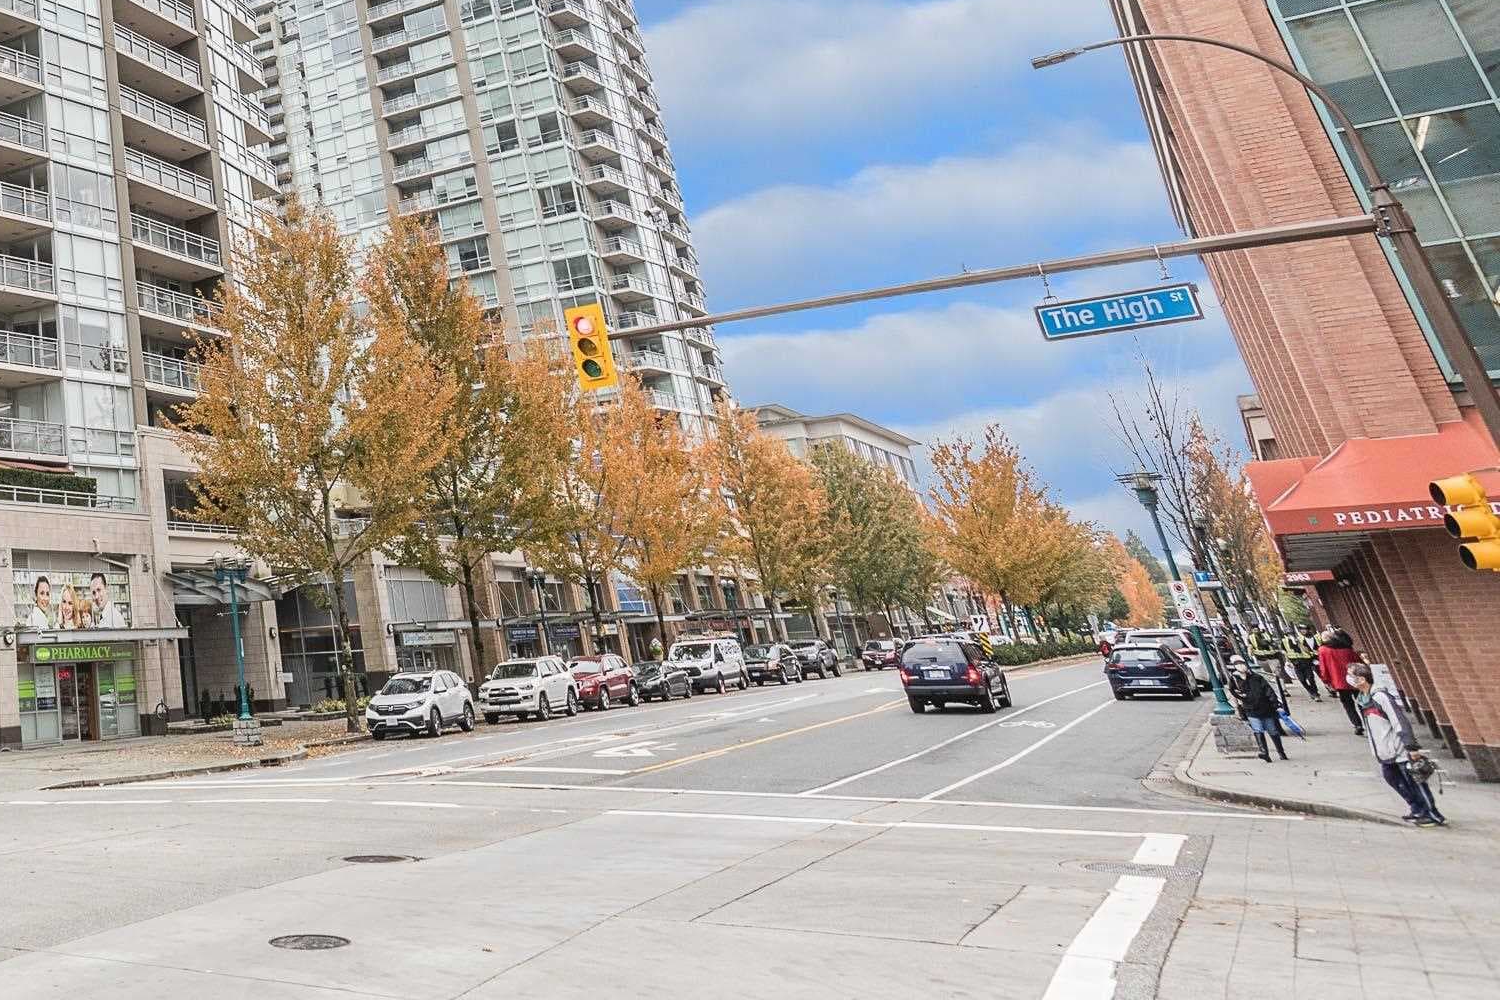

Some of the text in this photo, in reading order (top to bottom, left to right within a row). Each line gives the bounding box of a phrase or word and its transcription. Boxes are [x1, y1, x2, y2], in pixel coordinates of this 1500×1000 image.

[1049, 291, 1184, 329] The High St
[51, 647, 111, 659] PHARMACY
